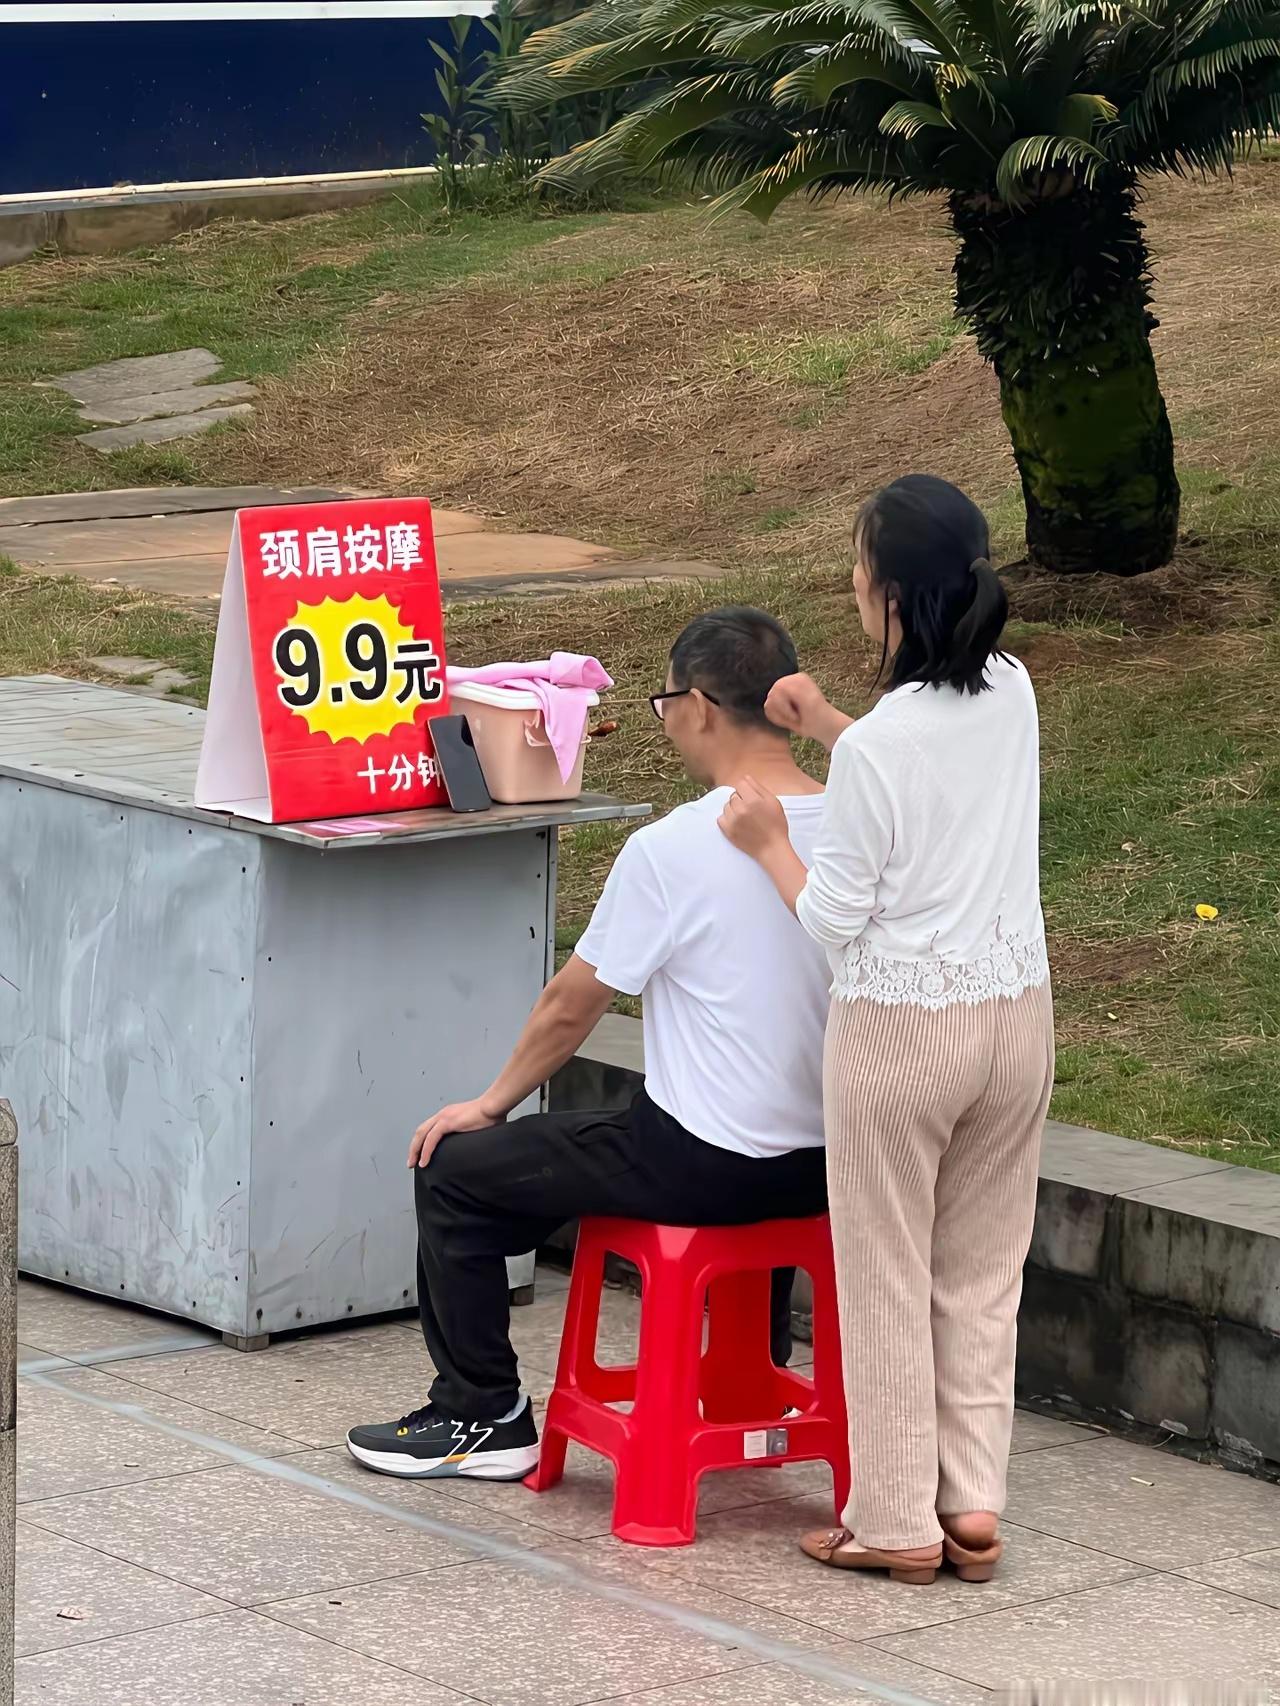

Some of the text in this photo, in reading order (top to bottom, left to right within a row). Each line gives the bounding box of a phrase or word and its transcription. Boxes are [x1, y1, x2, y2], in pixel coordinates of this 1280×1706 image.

[260, 522, 424, 579] 颈肩按摩
[275, 622, 441, 707] 9.9元
